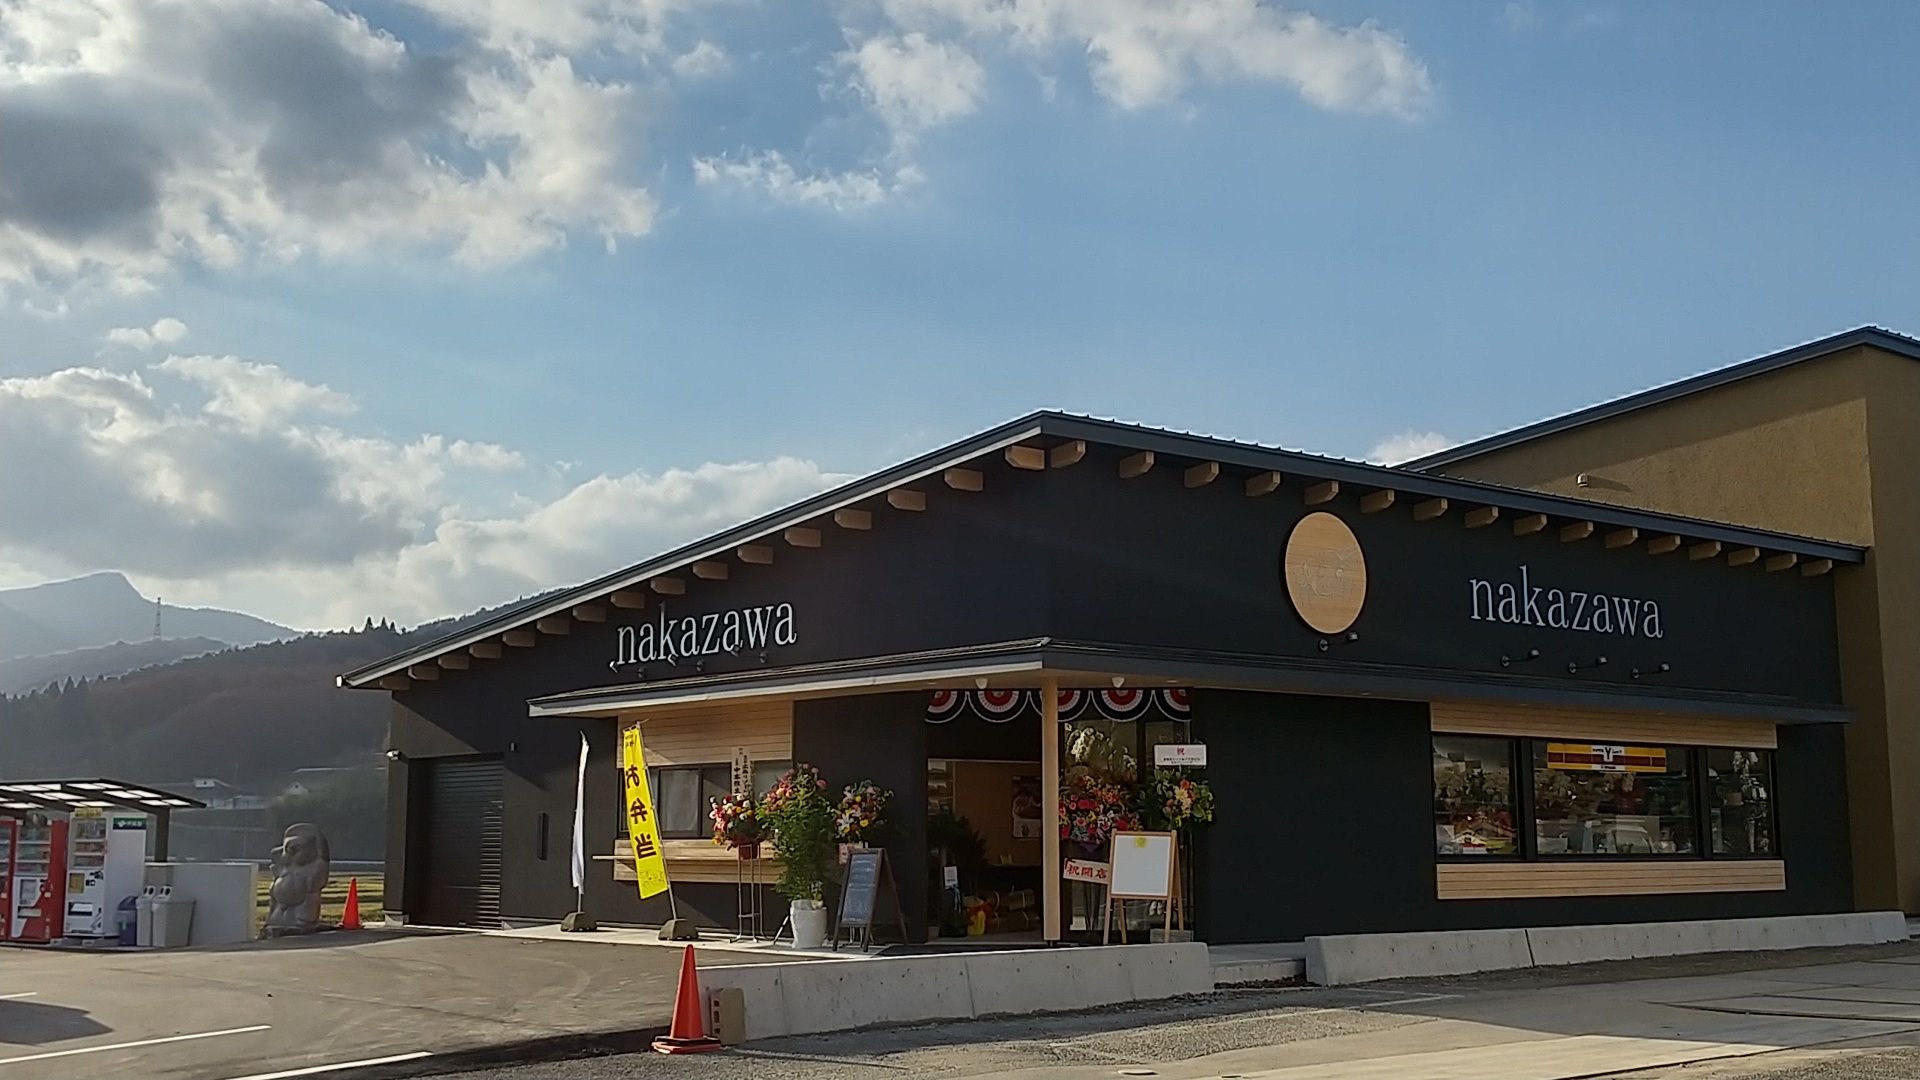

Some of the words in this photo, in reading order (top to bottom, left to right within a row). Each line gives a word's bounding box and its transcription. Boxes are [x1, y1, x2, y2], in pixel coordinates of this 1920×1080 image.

[617, 601, 798, 665] nakazawa
[1469, 564, 1664, 639] nakazawa
[1067, 863, 1108, 879] 祝開店
